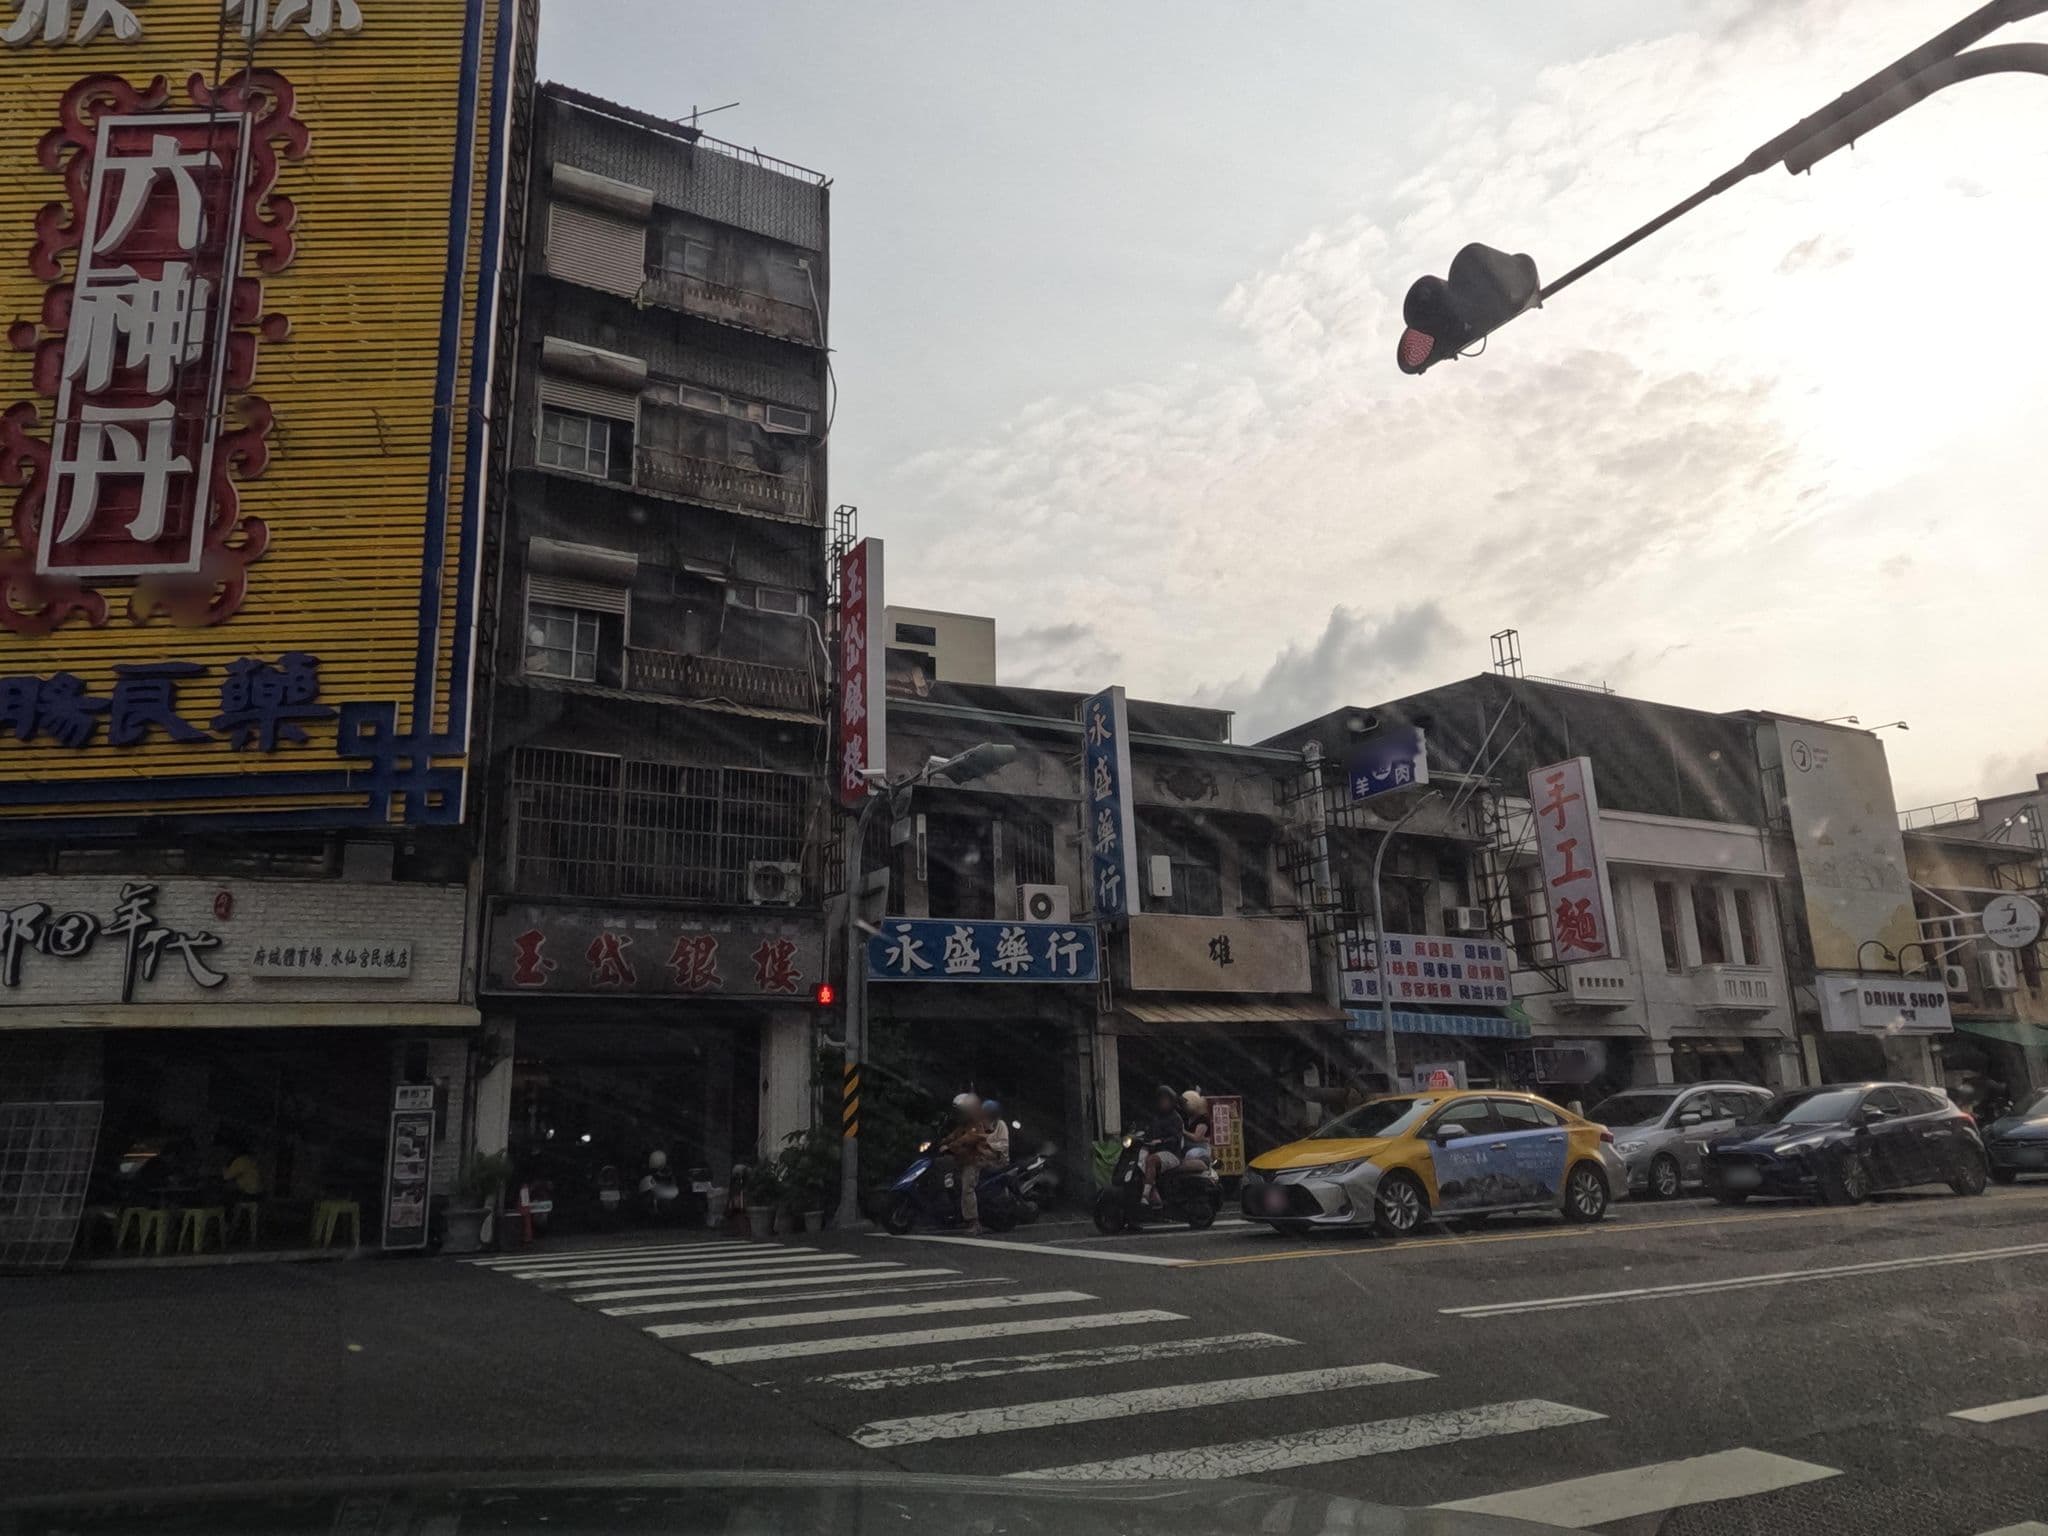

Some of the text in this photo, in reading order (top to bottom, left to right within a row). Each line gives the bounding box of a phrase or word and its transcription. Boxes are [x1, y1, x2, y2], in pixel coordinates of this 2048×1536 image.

[56, 133, 224, 545] 六神丹
[842, 556, 867, 792] 玉岱銀樓
[1087, 701, 1121, 909] 永盛藥行
[1538, 770, 1606, 954] 手工麵
[511, 926, 804, 995] 玉岱銀樓
[884, 922, 1086, 977] 永盛藥行
[1863, 989, 1945, 1009] DRINK SHOP
